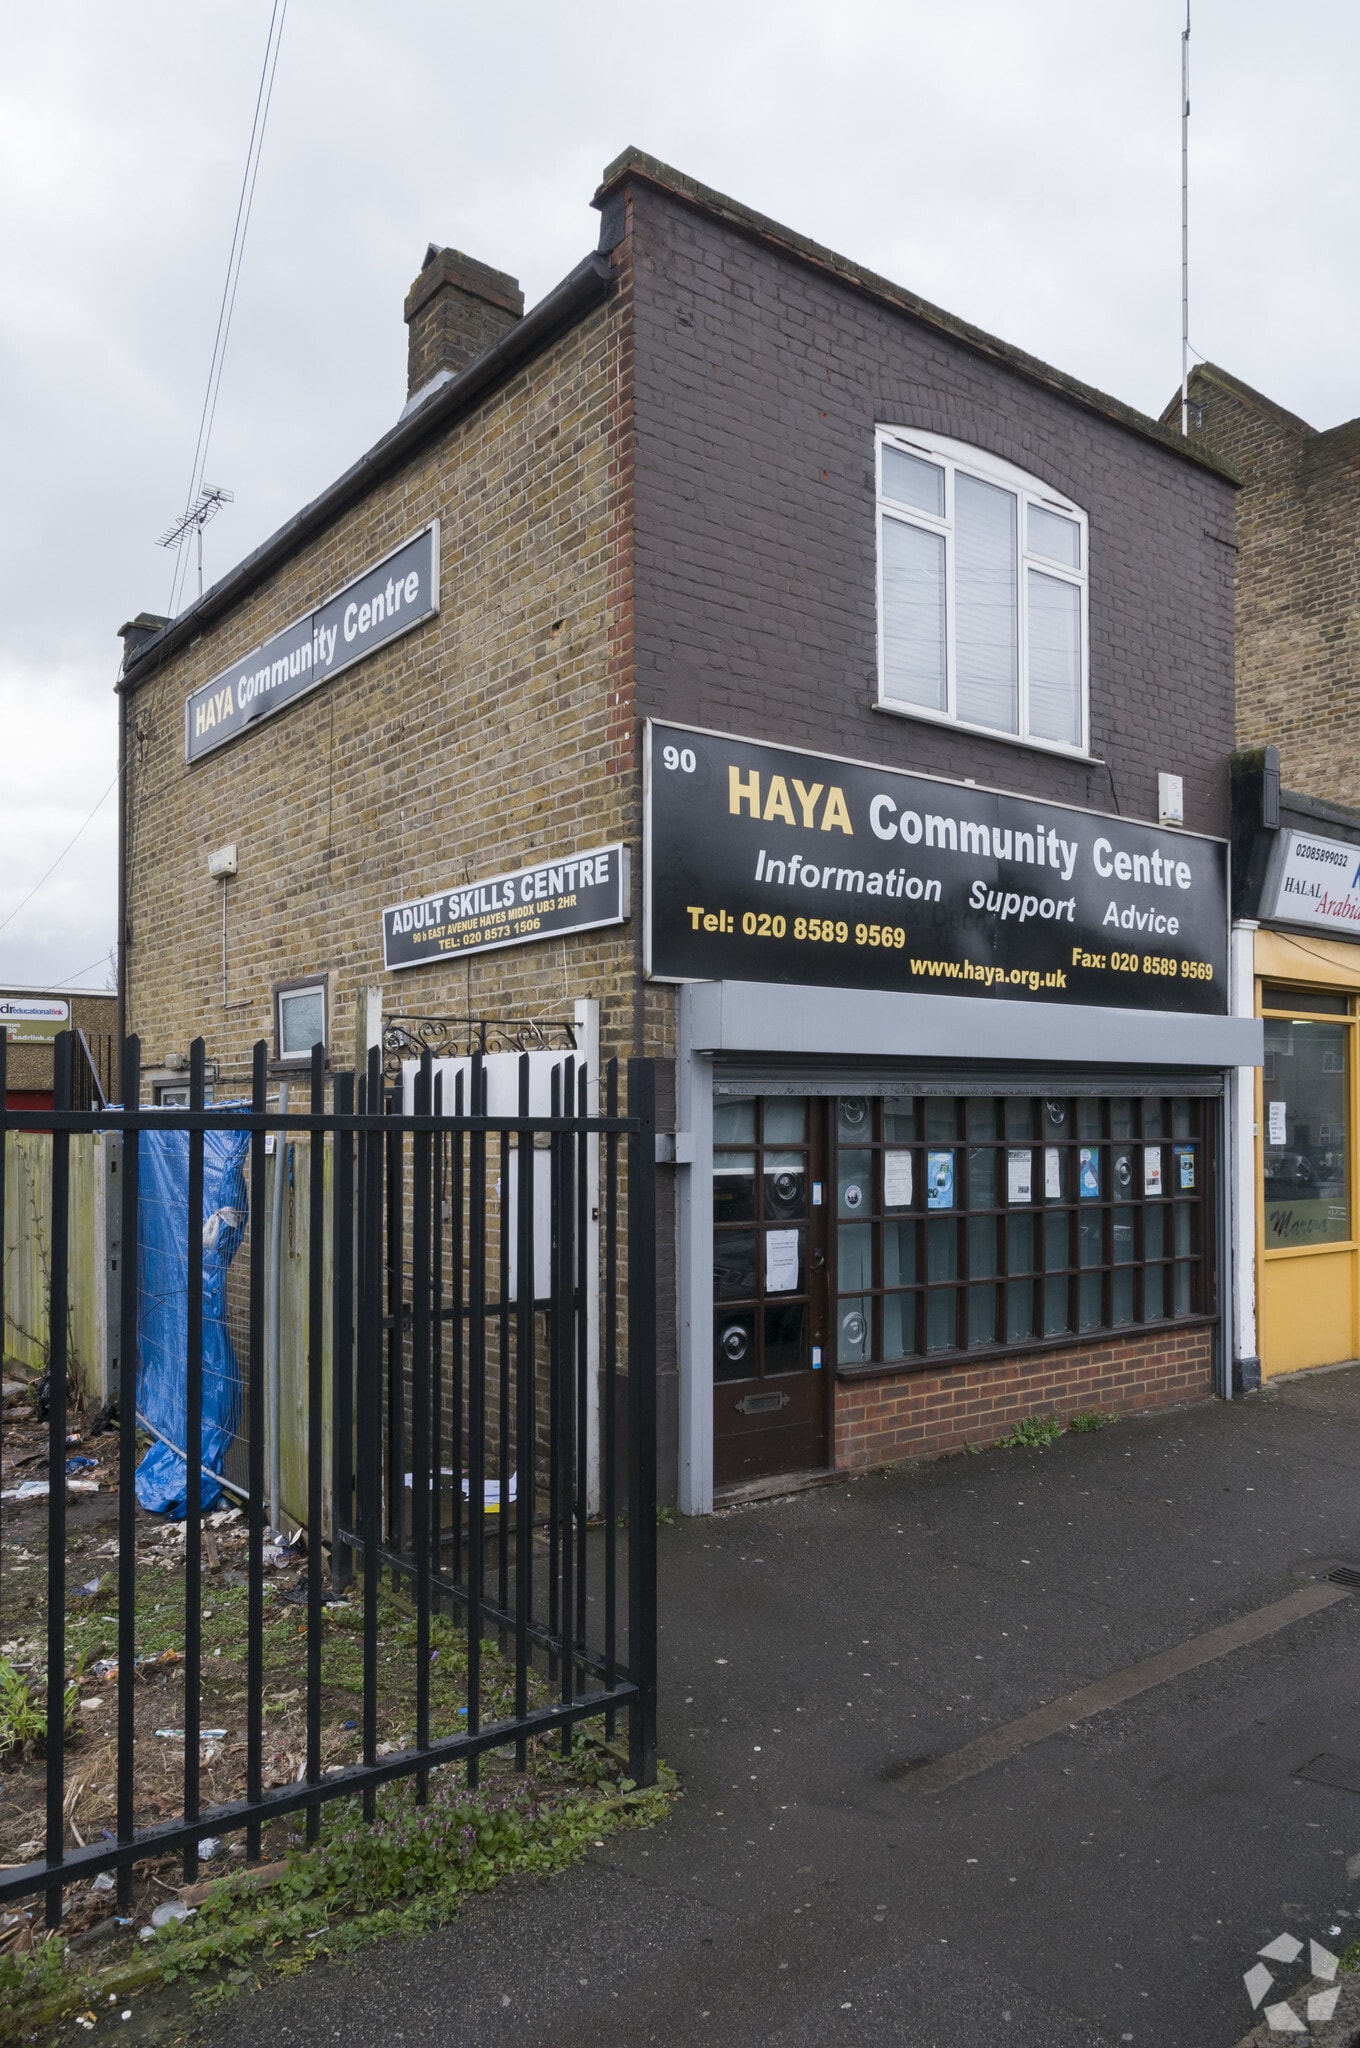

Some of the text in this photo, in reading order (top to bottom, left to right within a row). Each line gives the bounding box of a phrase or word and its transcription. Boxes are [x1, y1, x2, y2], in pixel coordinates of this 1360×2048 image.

[195, 571, 419, 738] HAYA Community Centre
[663, 745, 697, 773] 90
[728, 765, 1192, 890] HAYA Community Centre
[1296, 843, 1348, 868] 02085899032
[392, 854, 609, 935] ADULT SKILLS CENTRE
[754, 849, 942, 902] Information
[968, 879, 1076, 923] Support
[1102, 901, 1180, 936] Advice
[1284, 876, 1322, 898] HALAL
[412, 932, 421, 944] 90
[428, 925, 446, 940] EAST
[447, 918, 478, 936] AVENUE
[480, 912, 507, 927] HAYES
[508, 905, 535, 920] MIDDX
[537, 900, 555, 914] UB3
[557, 894, 577, 909] 2HR
[438, 917, 541, 951] TEL: 020 8573 1506
[686, 906, 734, 934] Tel:
[742, 912, 787, 939] 020
[794, 917, 849, 943] 8589
[855, 923, 906, 949] 9569
[910, 958, 1067, 991] www.haya.org.uk
[1072, 947, 1214, 981] Fax: 020 8589 9569
